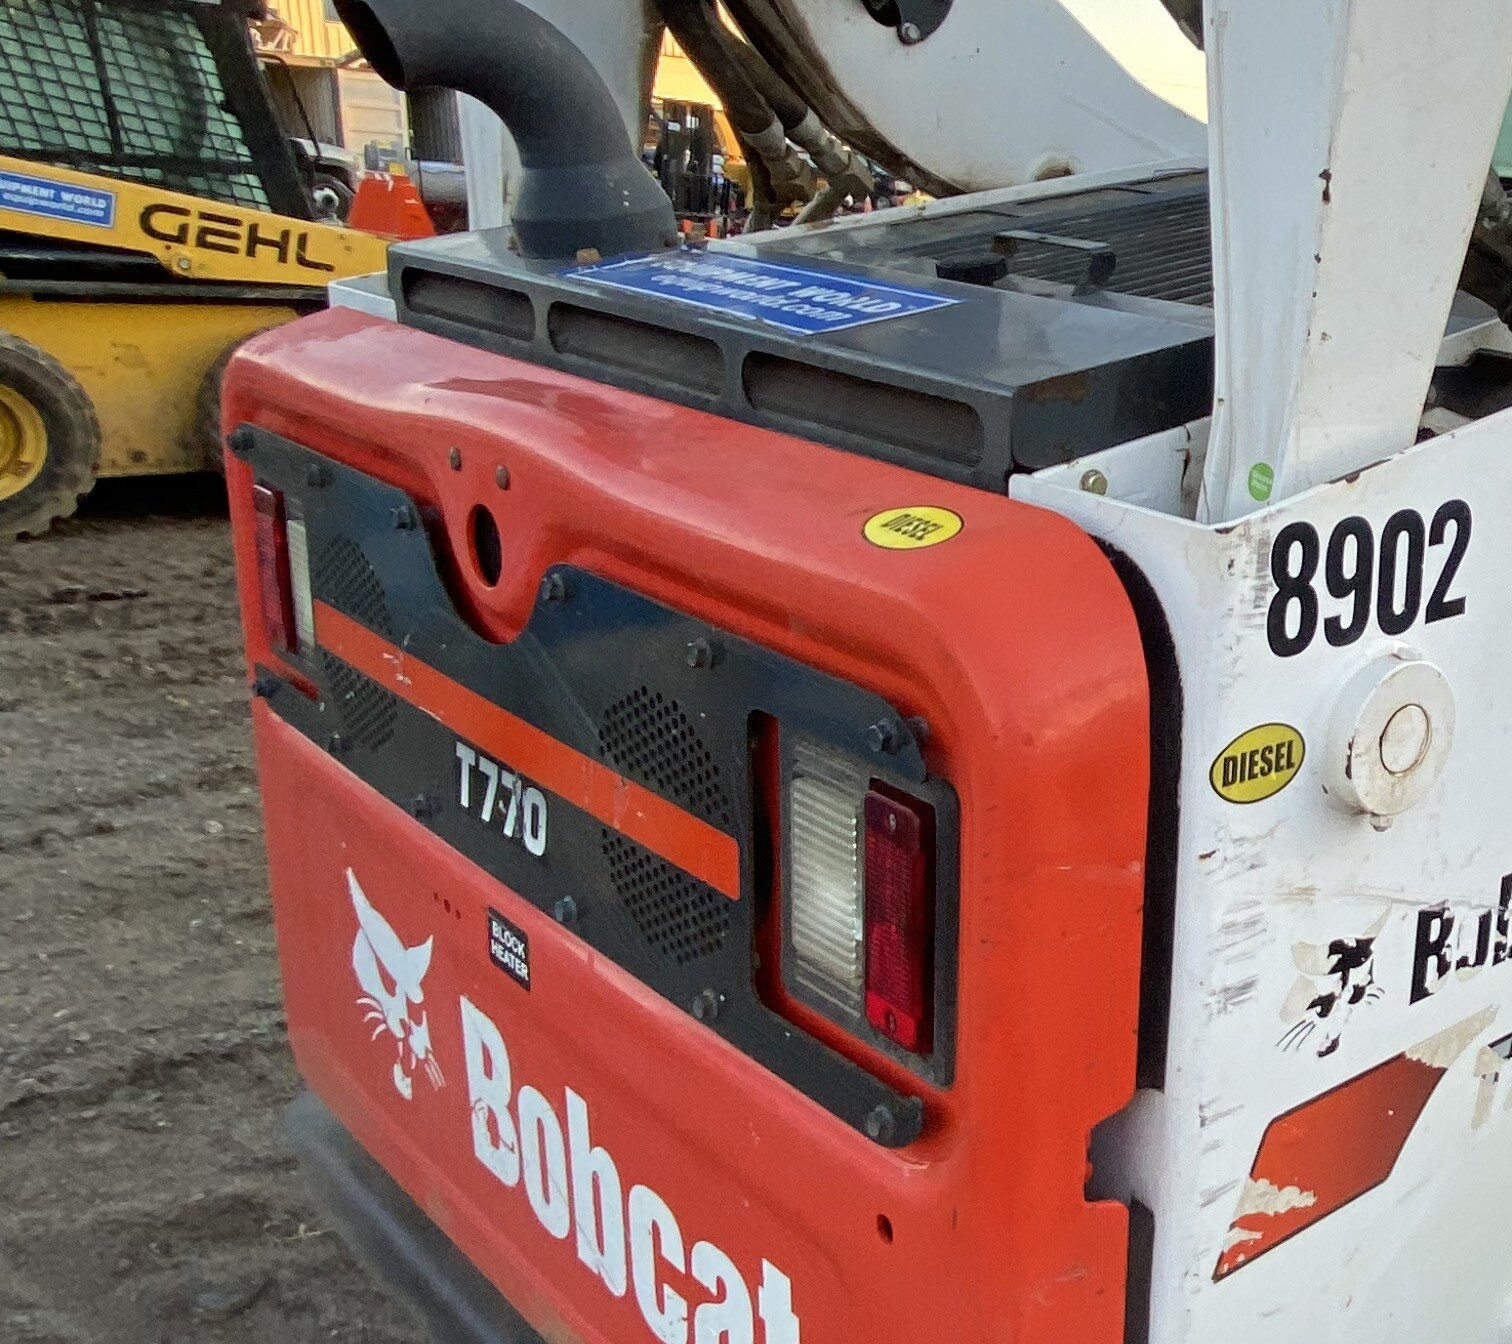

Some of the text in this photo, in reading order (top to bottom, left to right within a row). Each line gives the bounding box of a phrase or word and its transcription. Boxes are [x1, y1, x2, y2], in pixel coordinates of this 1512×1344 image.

[60, 191, 107, 208] WORLD
[140, 203, 335, 273] GEHL
[787, 285, 903, 314] WORLD
[880, 513, 944, 541] DIESEL
[1266, 499, 1473, 658] 8902
[1221, 739, 1296, 789] DIESEL
[456, 740, 548, 857] T770
[490, 937, 530, 982] HEATER
[491, 919, 526, 959] BLOCK
